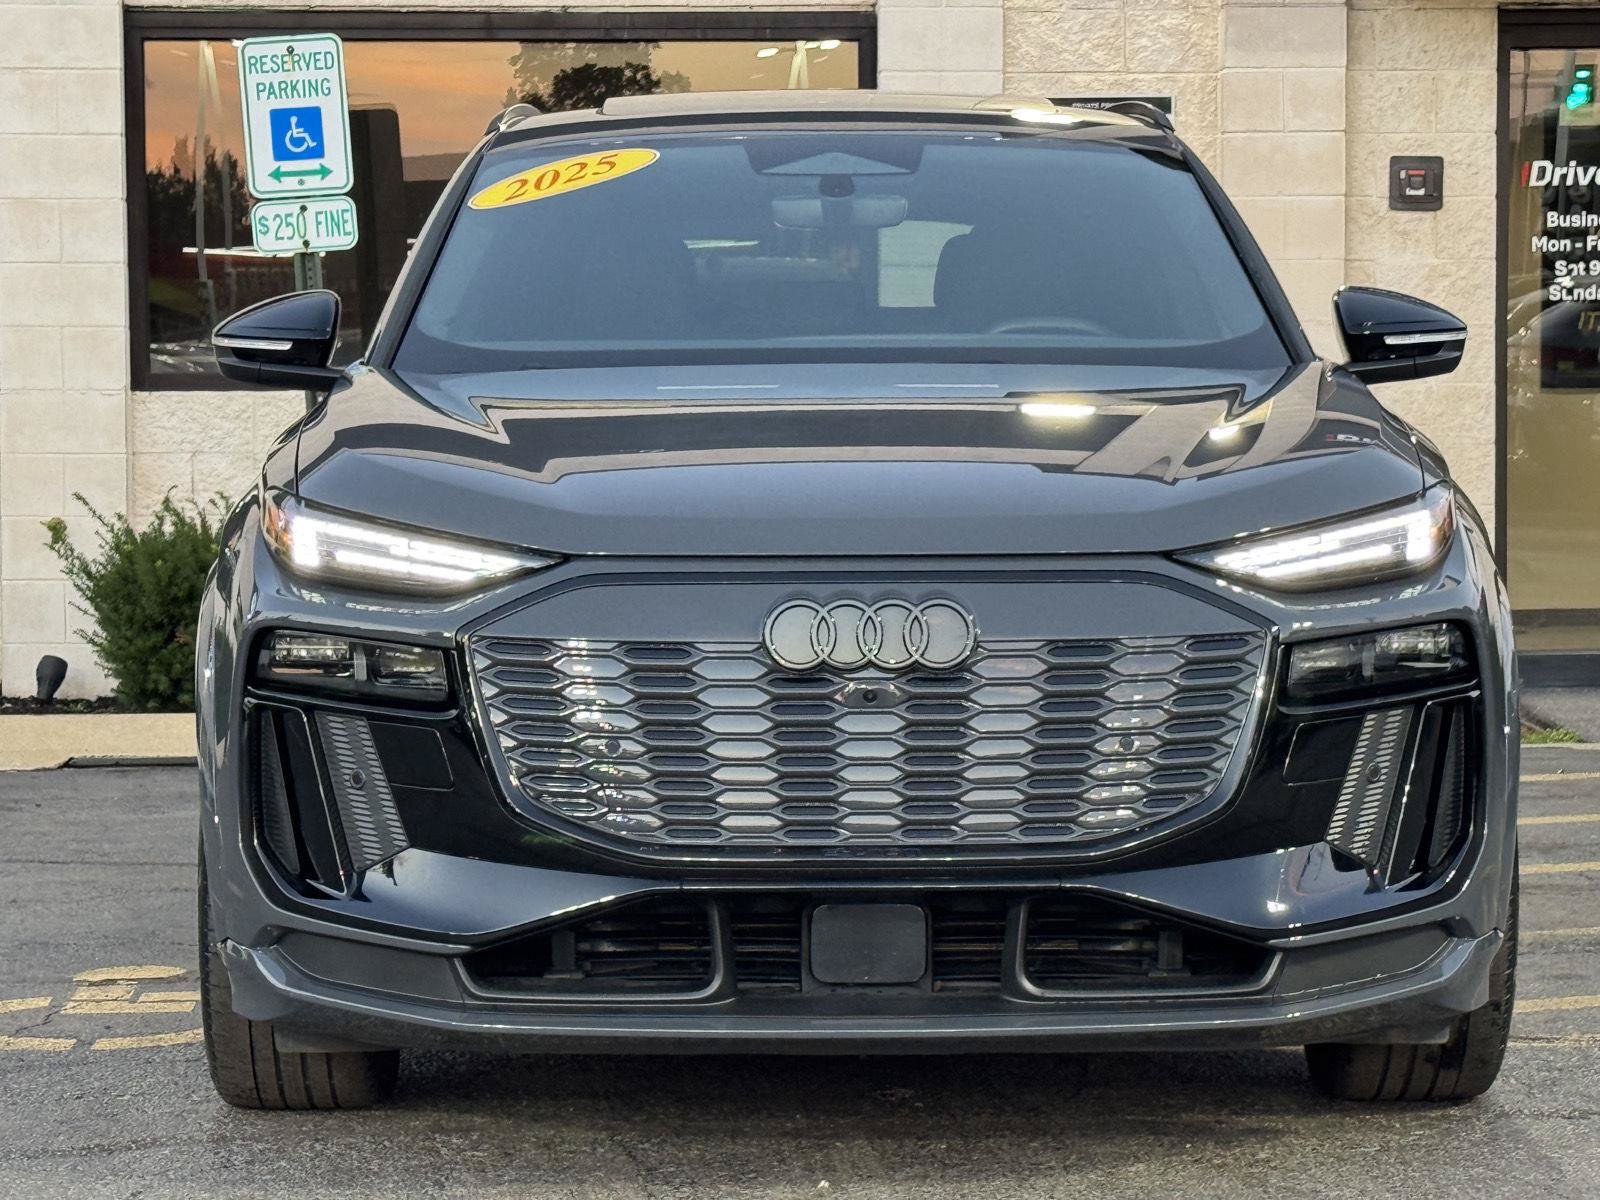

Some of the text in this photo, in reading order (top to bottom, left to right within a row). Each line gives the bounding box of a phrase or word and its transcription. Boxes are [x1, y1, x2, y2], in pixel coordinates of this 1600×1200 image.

[248, 51, 334, 74] RESERVED
[256, 78, 331, 101] PARKING
[503, 153, 618, 202] 2025
[258, 209, 352, 241] $250 FINE
[1546, 210, 1600, 228] Busin
[1531, 235, 1571, 253] Mon
